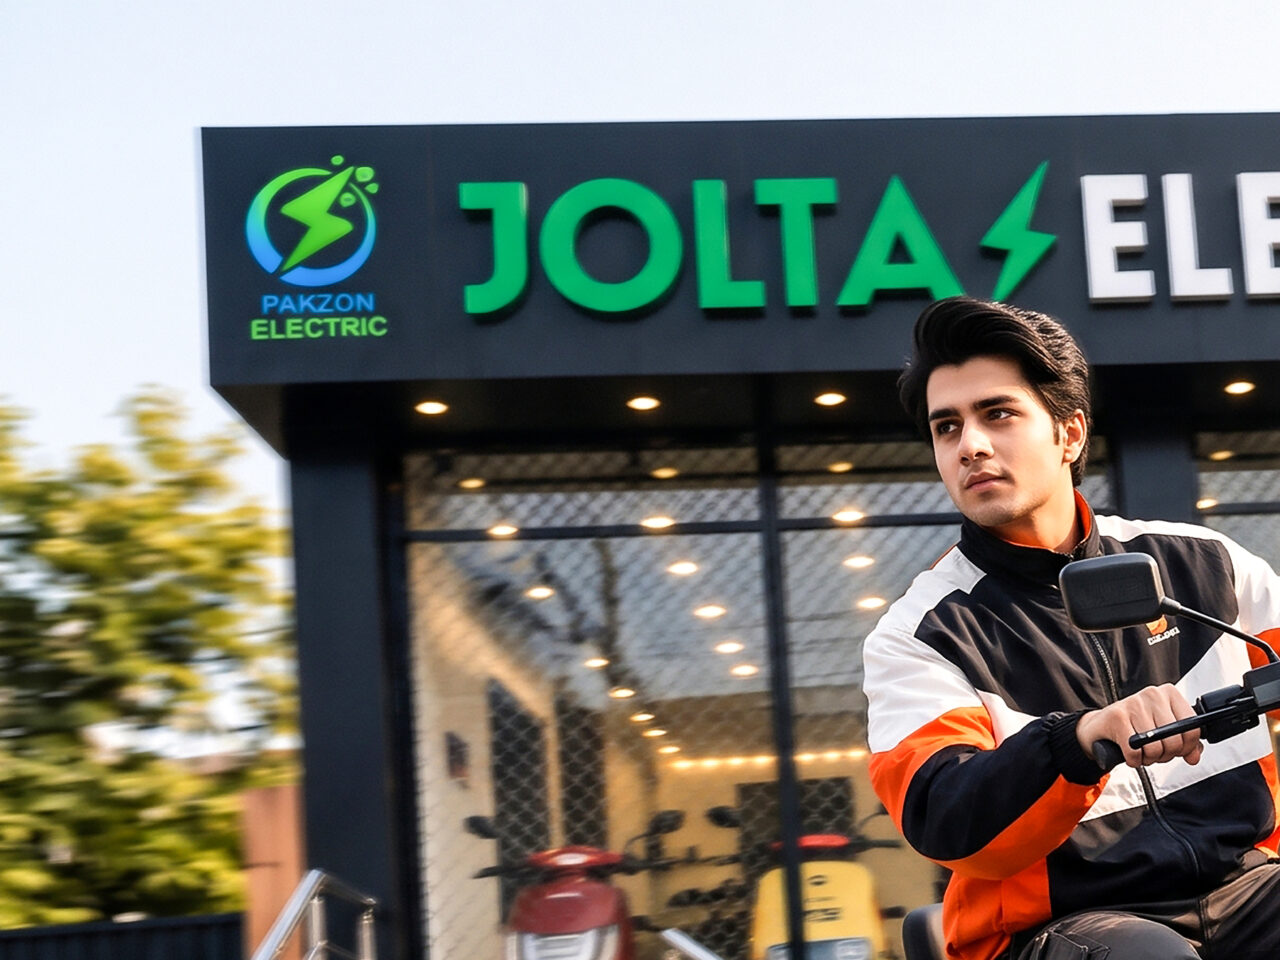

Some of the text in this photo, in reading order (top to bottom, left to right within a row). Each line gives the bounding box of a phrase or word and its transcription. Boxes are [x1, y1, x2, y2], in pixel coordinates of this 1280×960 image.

[459, 174, 966, 315] JOLTA
[261, 292, 376, 315] PAKZON
[250, 316, 388, 340] ELECTRIC
